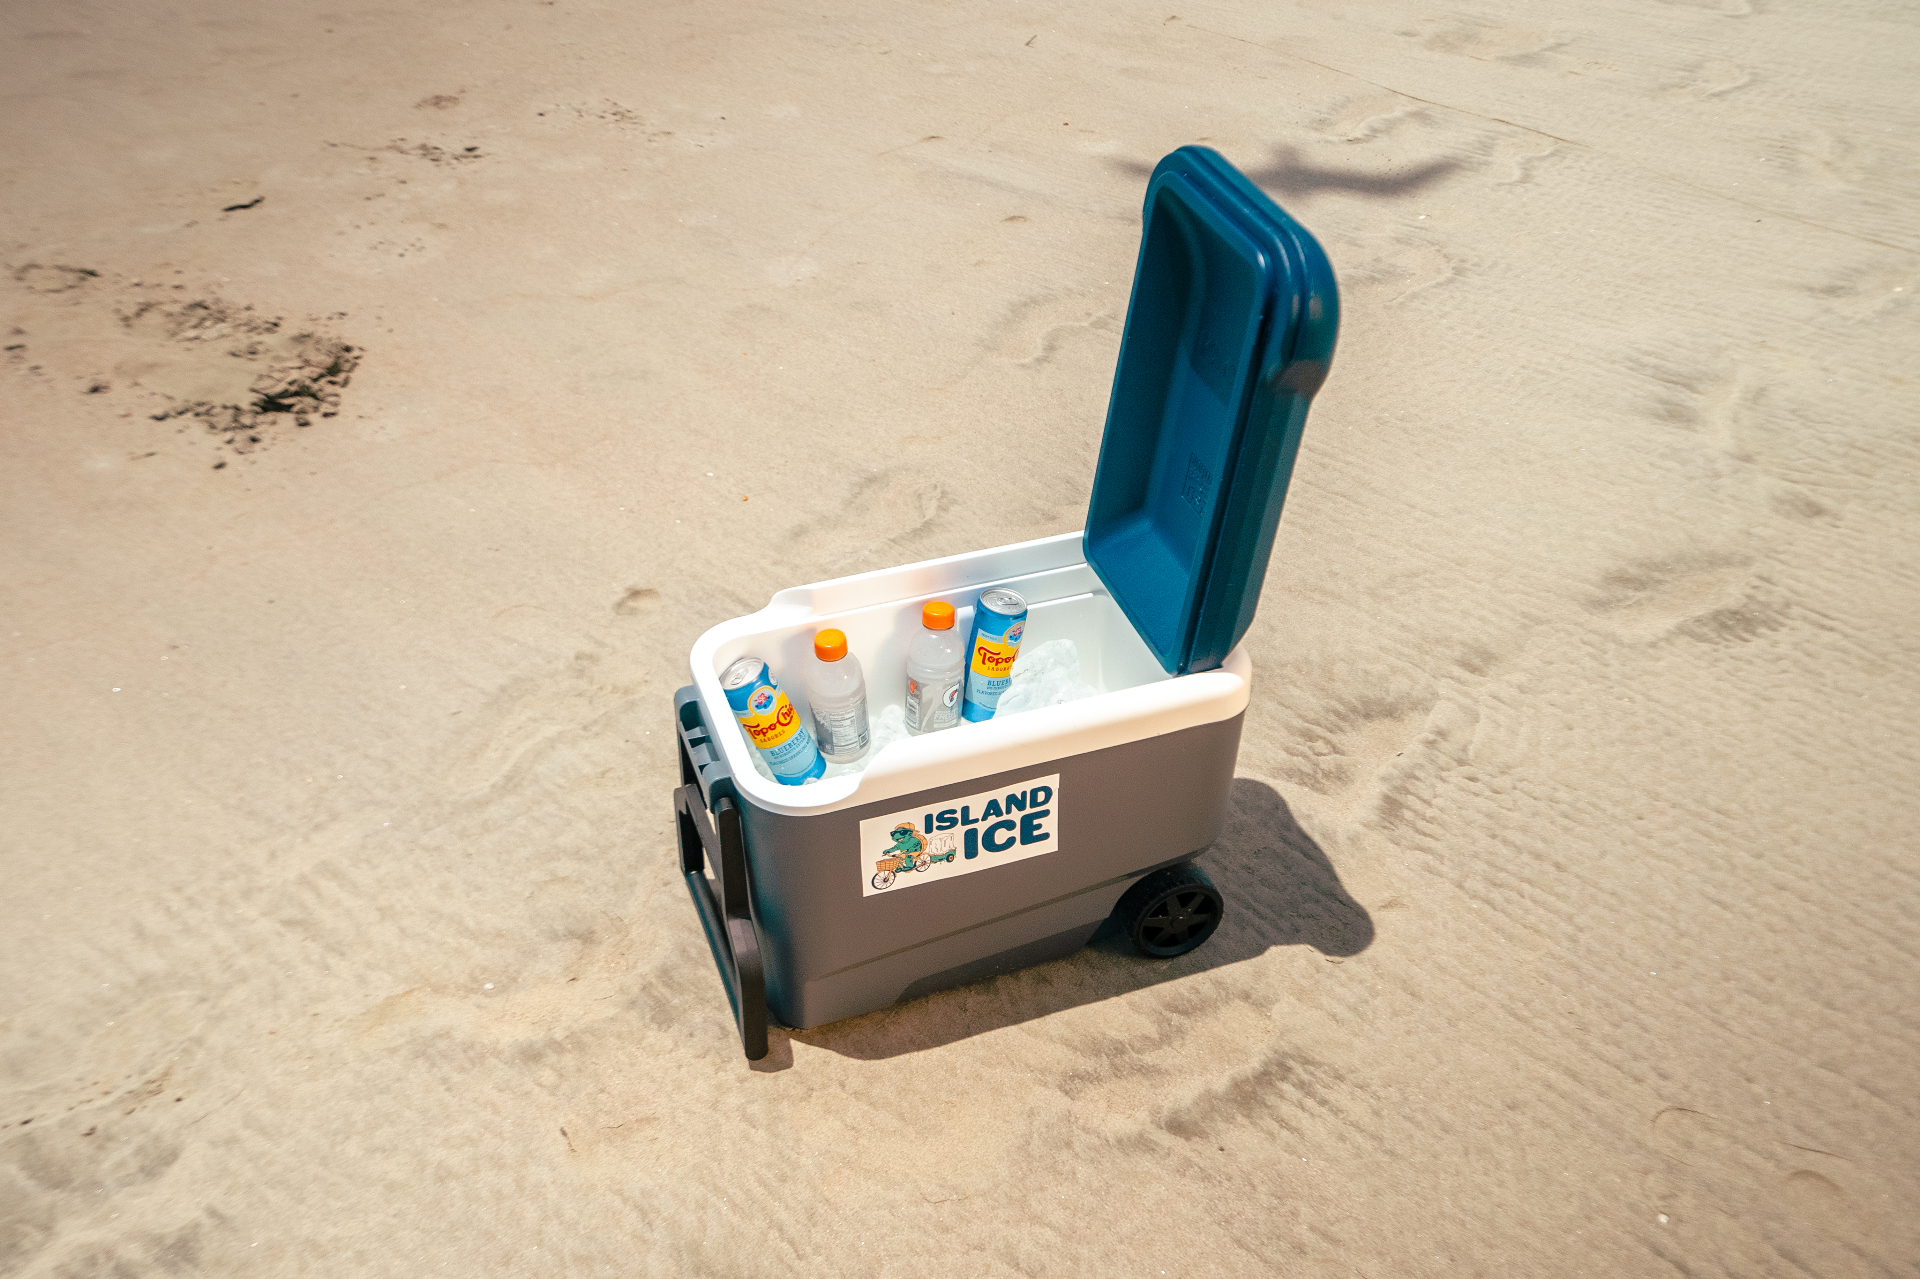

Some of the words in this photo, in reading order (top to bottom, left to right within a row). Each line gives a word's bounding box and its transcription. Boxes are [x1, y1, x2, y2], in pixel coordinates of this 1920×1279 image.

[978, 645, 1012, 666] Topo
[742, 722, 776, 740] Topo
[759, 729, 786, 743] SABORES
[769, 728, 805, 756] BLUEBERRY
[924, 785, 1053, 834] ISLAND
[963, 808, 1051, 860] ICE
